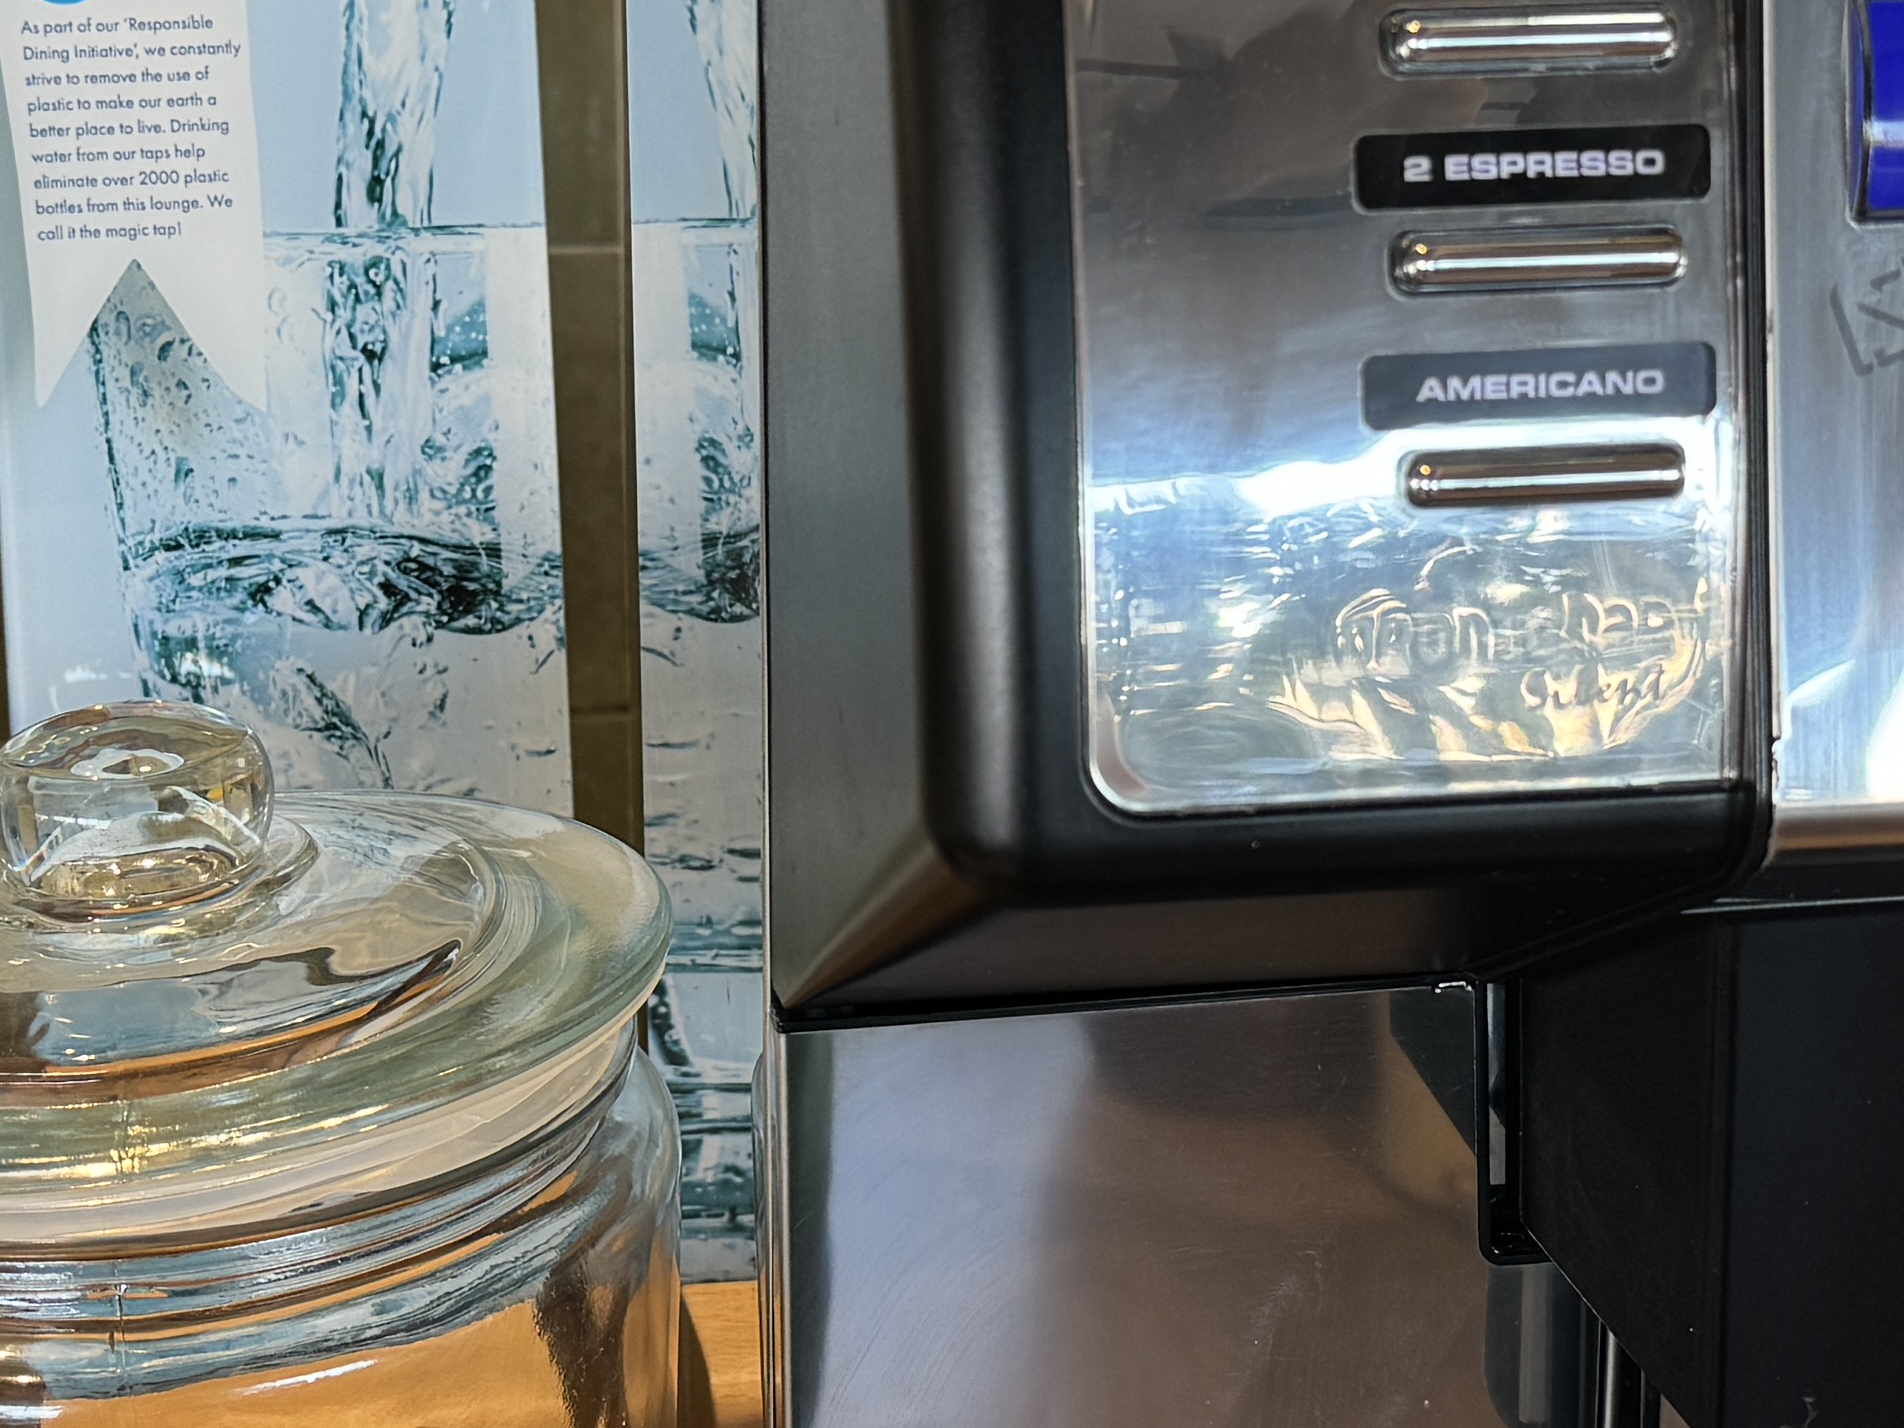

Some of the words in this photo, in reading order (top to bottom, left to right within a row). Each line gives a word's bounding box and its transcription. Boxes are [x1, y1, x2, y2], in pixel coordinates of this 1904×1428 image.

[21, 20, 40, 35] As
[44, 21, 73, 37] part
[77, 17, 92, 32] of
[95, 21, 119, 33] our
[23, 45, 70, 64] Dining
[143, 46, 166, 58] we
[170, 39, 241, 58] constantly
[25, 73, 62, 87] strive
[66, 71, 80, 86] to
[84, 73, 137, 85] remove
[141, 67, 163, 83] the
[167, 70, 191, 82] use
[195, 65, 210, 81] of
[27, 96, 74, 116] plastic
[77, 96, 91, 111] to
[95, 94, 134, 110] make
[138, 96, 161, 109] our
[166, 92, 203, 108] earth
[207, 96, 217, 106] a
[29, 123, 71, 138] better
[75, 121, 115, 140] place
[119, 122, 134, 135] to
[137, 119, 166, 134] live.
[170, 117, 230, 135] Drinking
[31, 149, 72, 164] water
[76, 146, 109, 162] from
[113, 149, 136, 161] our
[140, 146, 171, 163] taps
[174, 143, 206, 162] help
[1403, 155, 1432, 183] 2
[1444, 148, 1665, 181] ESPRESSO
[34, 174, 98, 190] eliminate
[102, 175, 135, 187] over
[139, 170, 180, 186] 2000
[184, 168, 230, 187] plastic
[35, 199, 83, 215] bottles
[86, 197, 119, 213] from
[123, 197, 146, 212] this
[150, 195, 203, 214] lounge.
[206, 194, 233, 209] We
[37, 225, 63, 241] call
[67, 226, 76, 239] it
[79, 224, 101, 239] the
[105, 223, 150, 241] magic
[1416, 369, 1664, 403] AMERICANO
